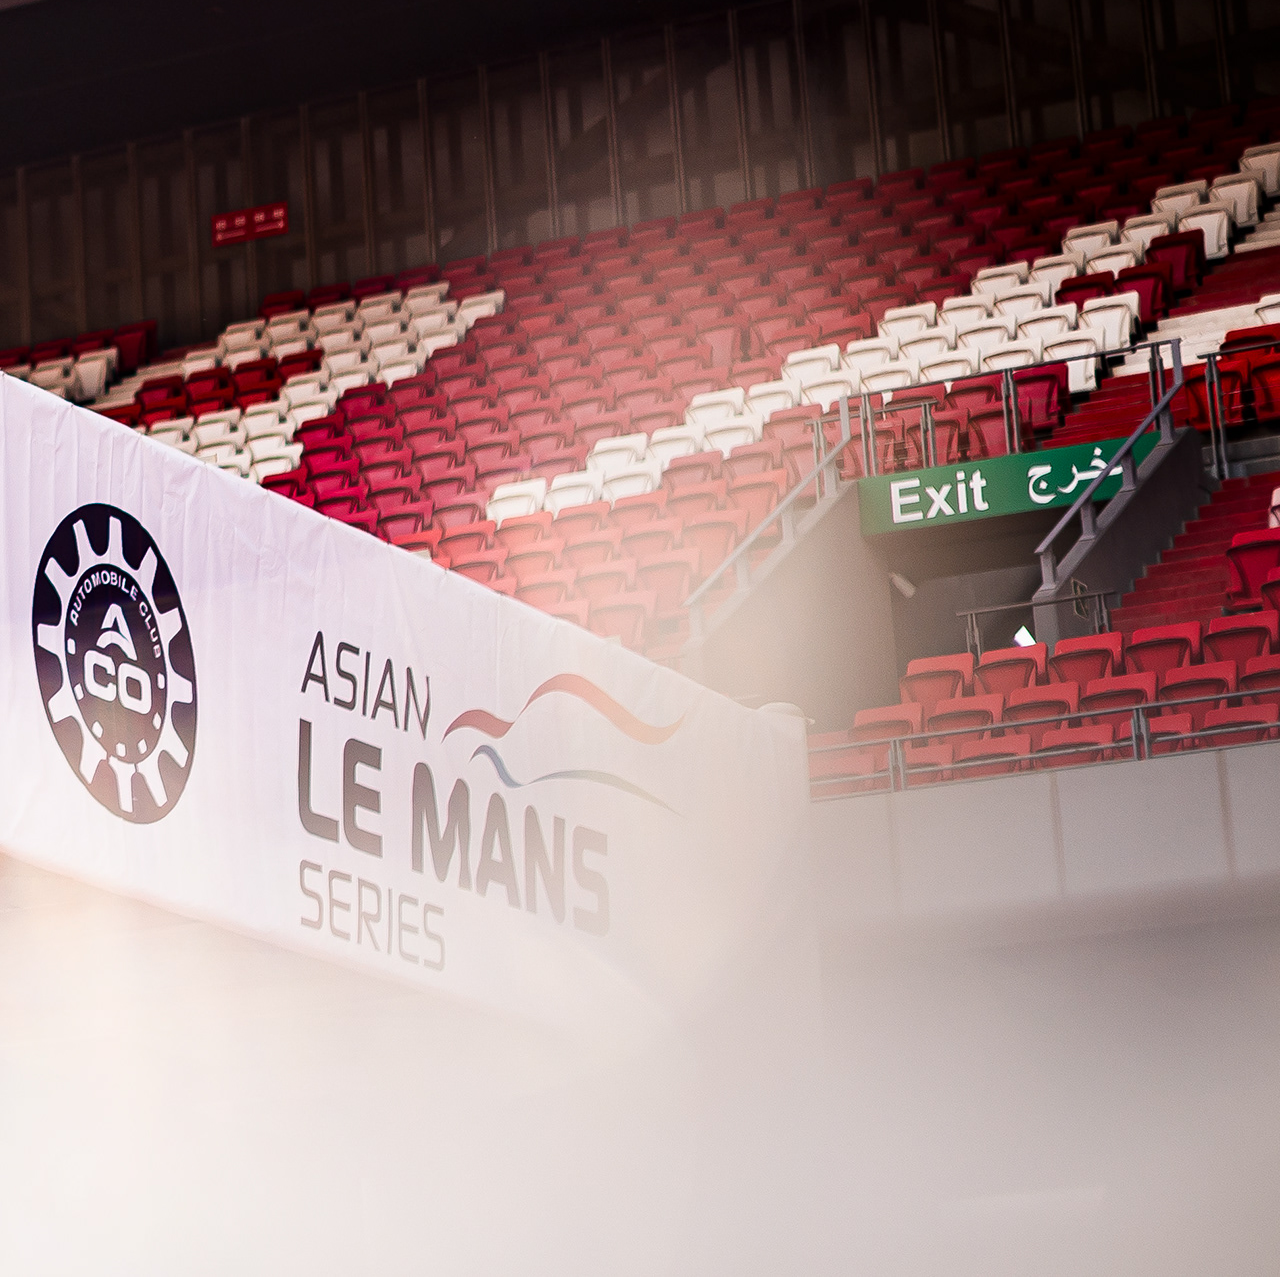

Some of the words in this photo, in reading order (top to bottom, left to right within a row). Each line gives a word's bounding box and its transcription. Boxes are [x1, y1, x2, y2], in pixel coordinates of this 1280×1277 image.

[890, 469, 990, 524] Exit
[1026, 446, 1124, 504] خرج
[69, 569, 139, 627] AUTOMOBILE
[138, 601, 162, 659] CLUB
[300, 630, 431, 742] ASIAN
[297, 717, 384, 858] LE
[412, 761, 611, 937] MANS
[299, 859, 447, 973] SERIES
